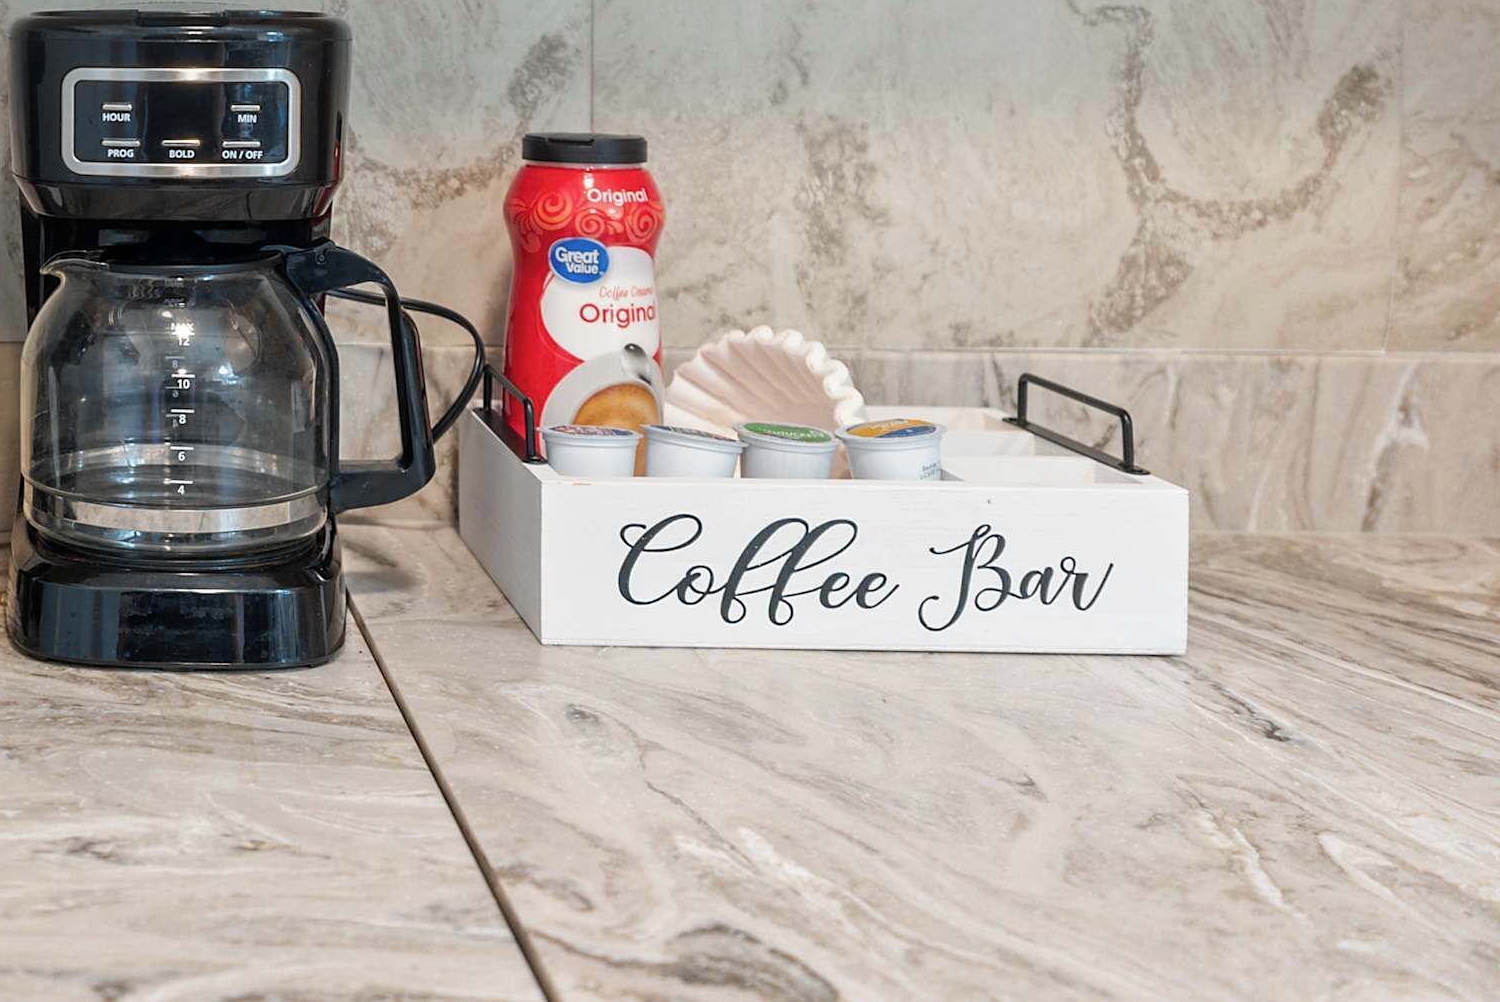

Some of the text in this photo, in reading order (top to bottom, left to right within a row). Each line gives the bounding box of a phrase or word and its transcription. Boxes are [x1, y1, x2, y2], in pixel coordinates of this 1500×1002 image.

[102, 113, 131, 123] HOUR
[237, 114, 258, 124] MIN
[107, 149, 135, 159] PROG
[168, 149, 195, 159] BOLD
[587, 187, 649, 207] Original
[555, 246, 600, 264] Great
[565, 262, 599, 275] Value
[178, 336, 191, 347] 12
[176, 378, 191, 390] 10
[178, 413, 187, 425] 8
[177, 451, 186, 462] 6
[177, 485, 185, 495] 4
[616, 512, 1115, 633] Coffee Bar
